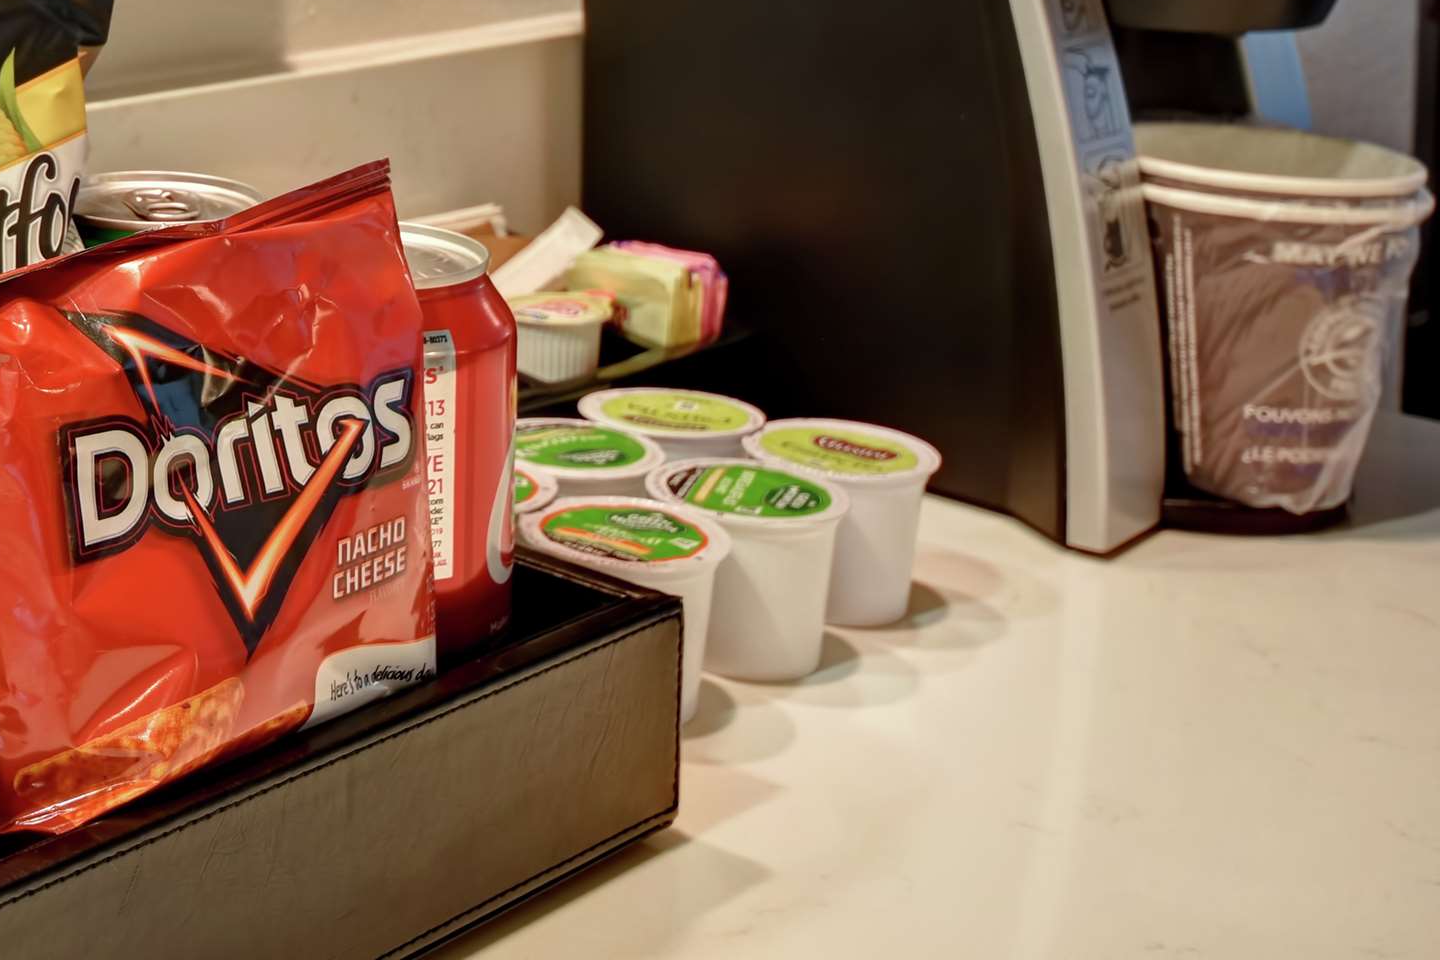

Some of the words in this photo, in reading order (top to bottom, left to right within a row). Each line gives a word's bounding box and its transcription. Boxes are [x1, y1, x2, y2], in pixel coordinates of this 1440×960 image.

[73, 377, 412, 548] Doritos
[337, 516, 406, 566] NACHO
[332, 546, 407, 600] CHEESE
[372, 663, 415, 682] delicious
